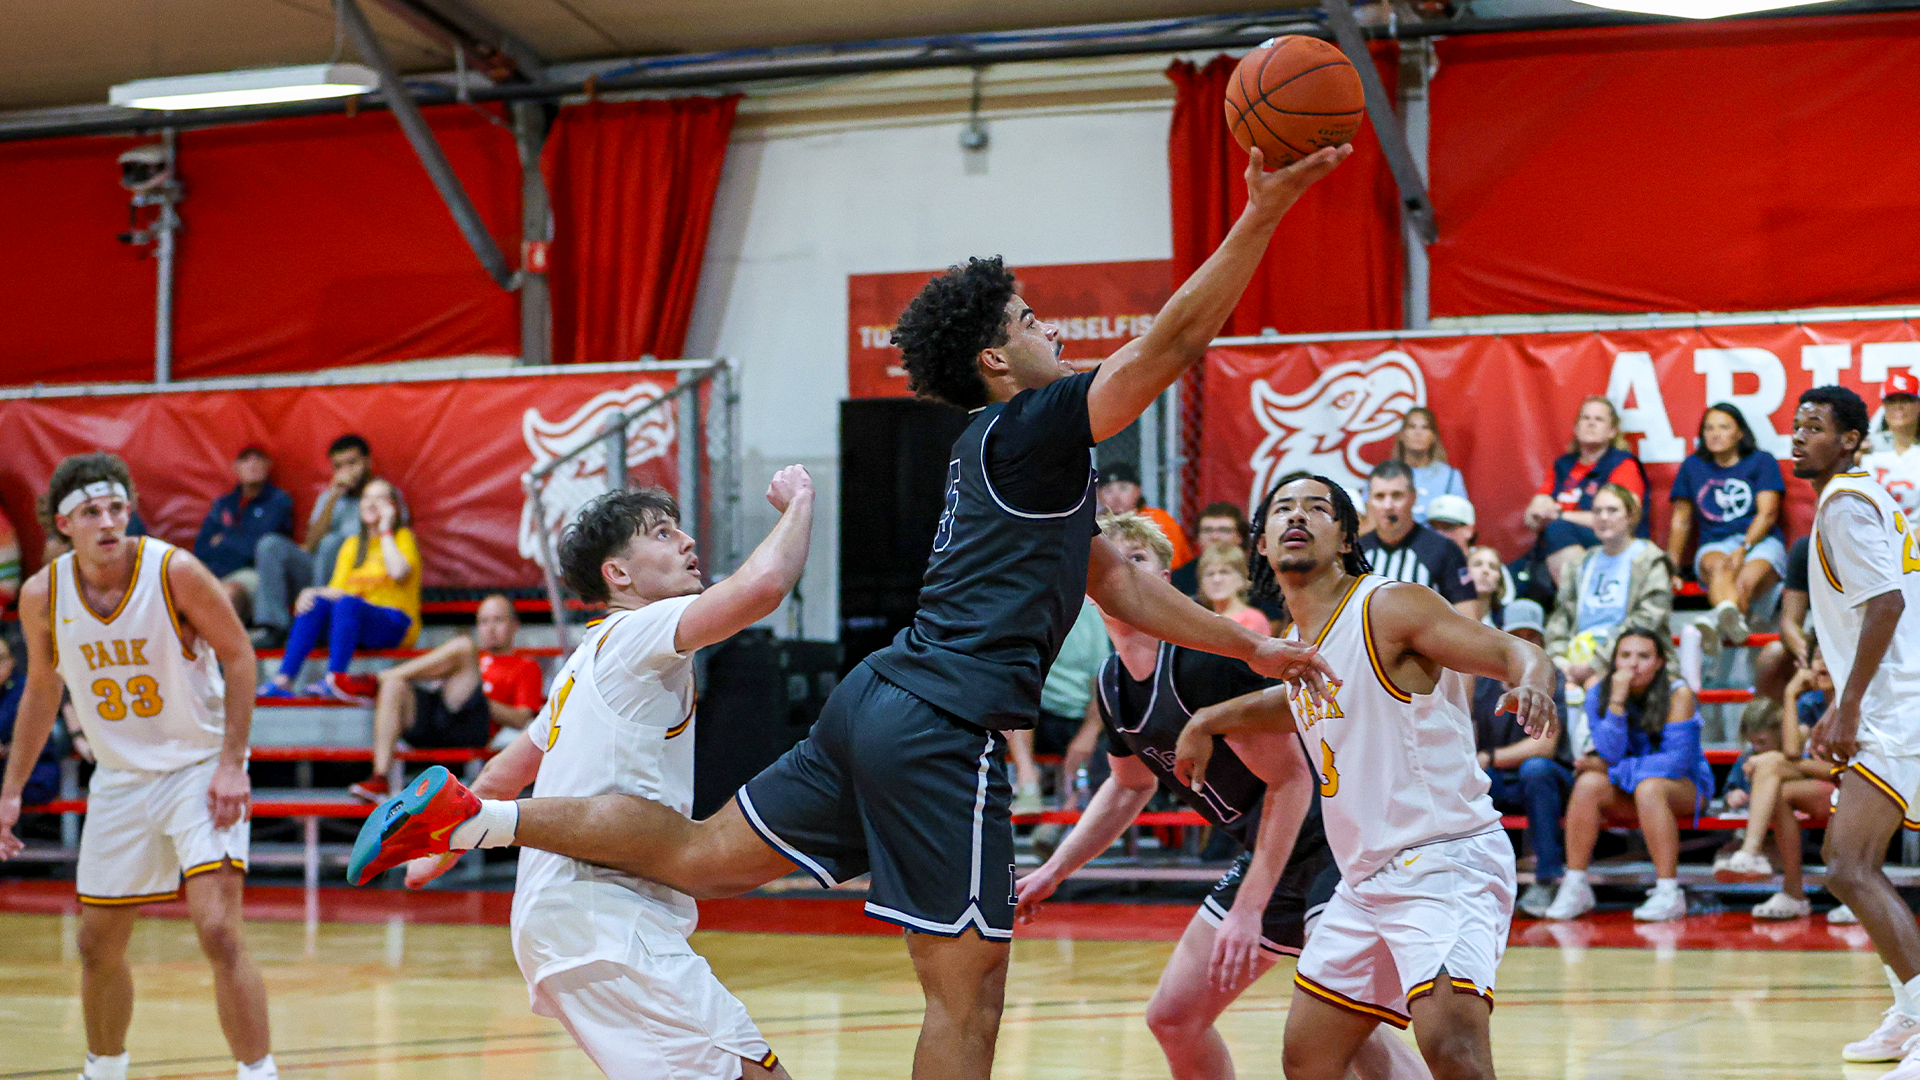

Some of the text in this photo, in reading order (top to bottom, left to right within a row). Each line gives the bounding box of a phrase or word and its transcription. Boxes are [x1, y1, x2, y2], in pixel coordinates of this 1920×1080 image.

[932, 458, 961, 553] 5
[79, 638, 149, 671] PARK
[91, 674, 163, 721] 33
